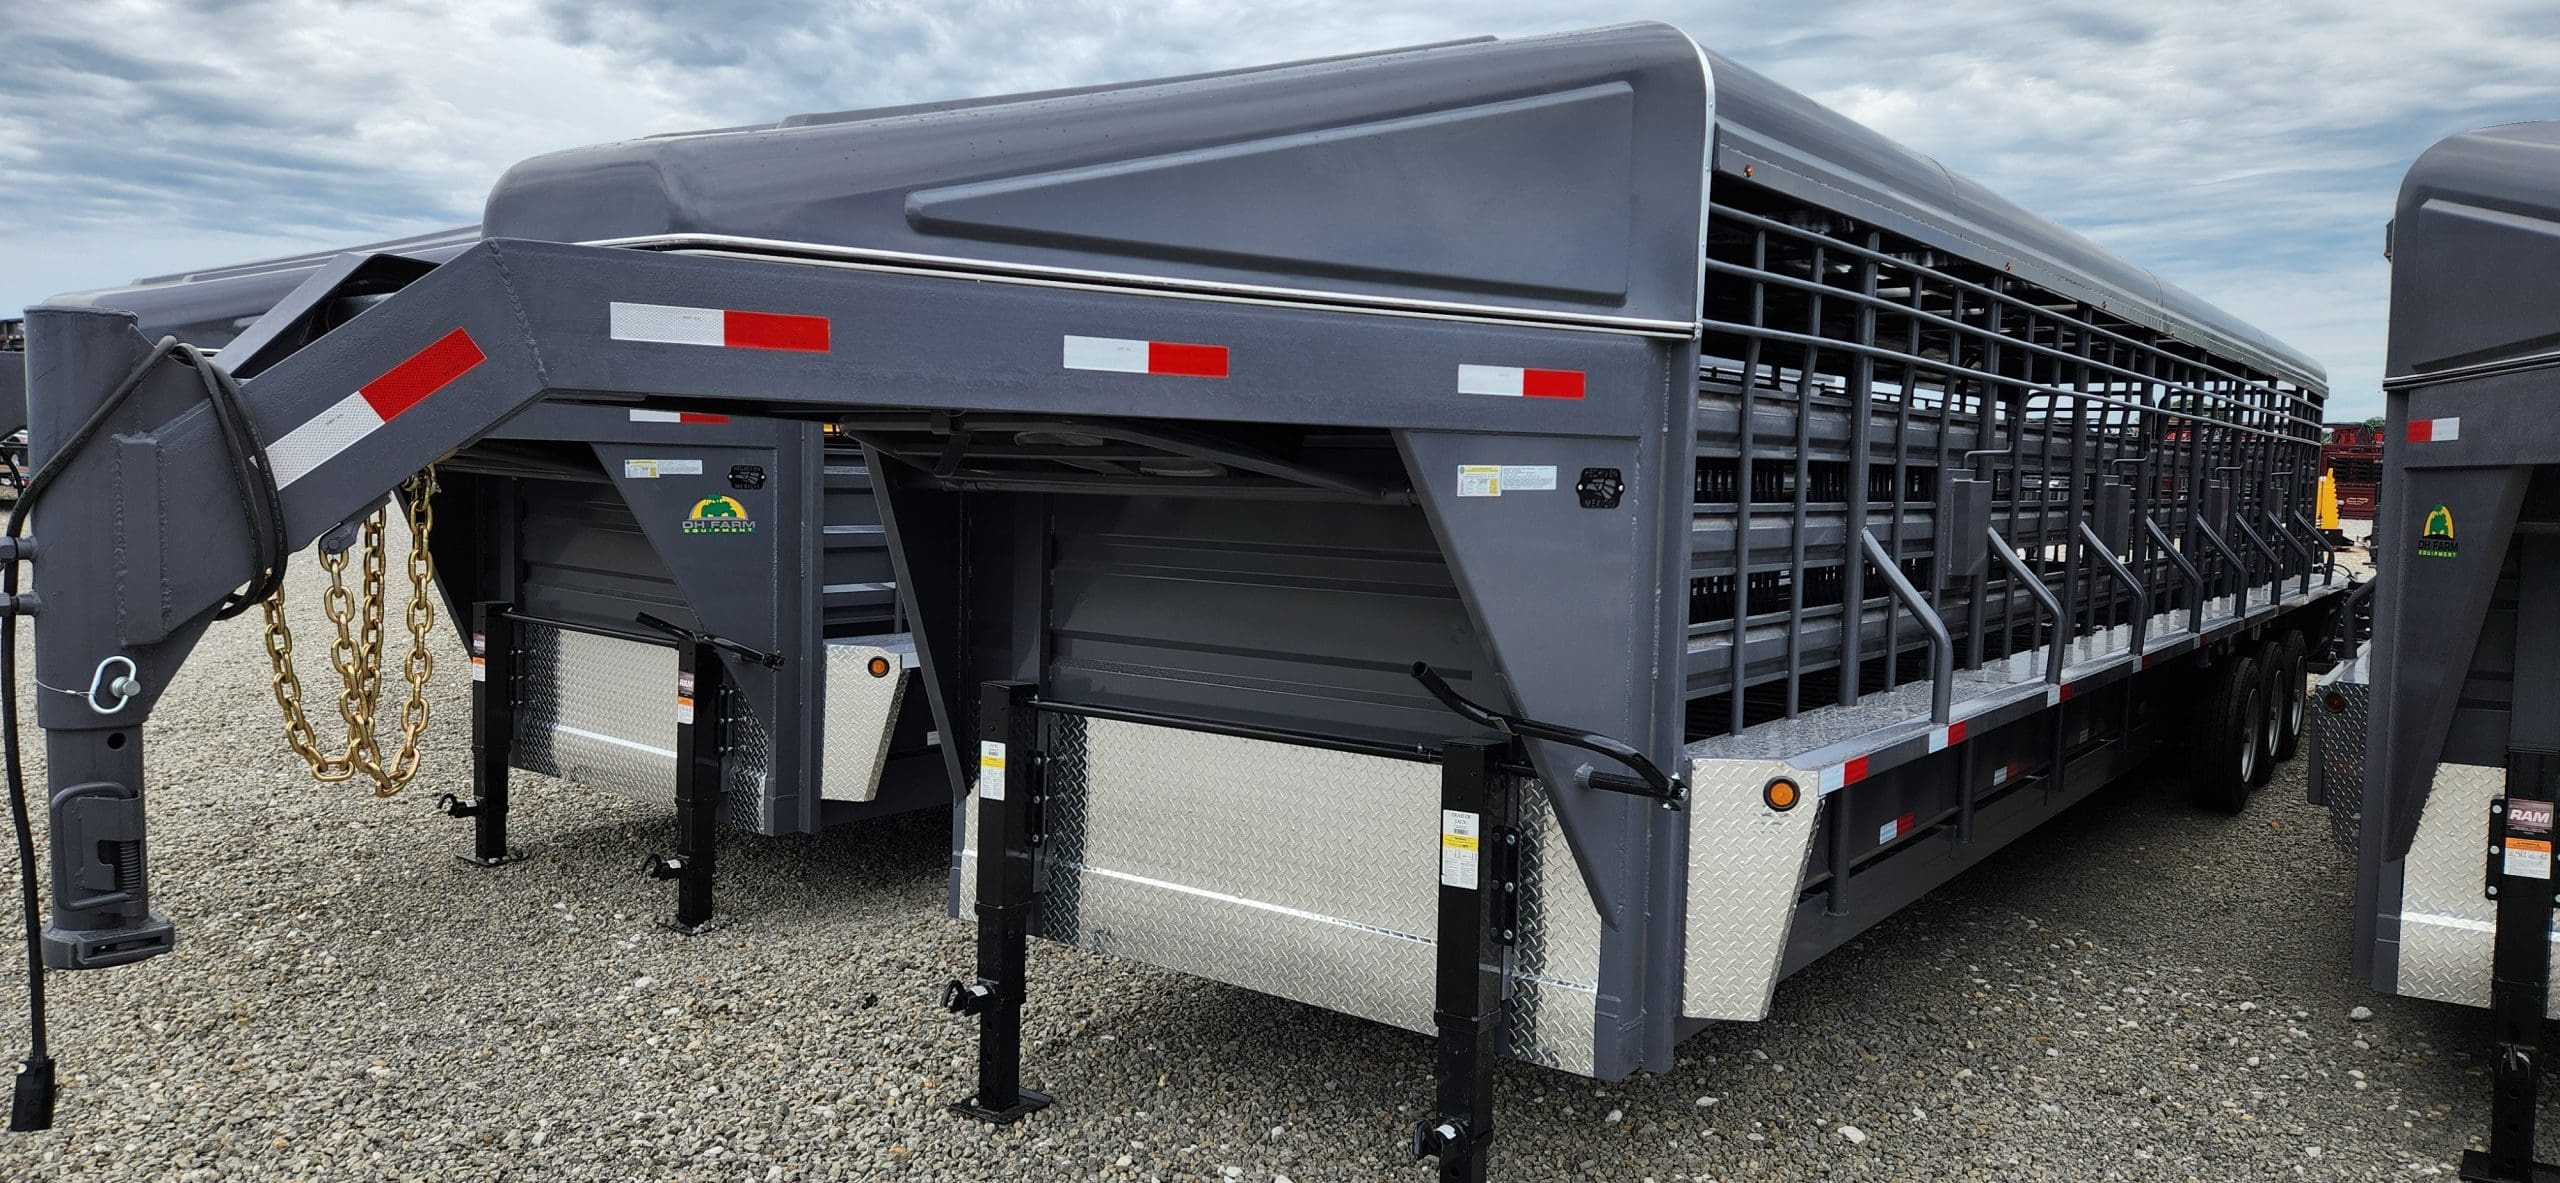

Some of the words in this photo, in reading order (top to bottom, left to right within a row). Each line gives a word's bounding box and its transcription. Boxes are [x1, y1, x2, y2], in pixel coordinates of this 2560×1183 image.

[682, 521, 705, 529] DH
[711, 521, 756, 529] FARM
[2418, 540, 2431, 550] DH
[2433, 541, 2460, 552] FARM
[2418, 550, 2457, 558] EQUIPMENT
[2510, 809, 2551, 824] RAM
